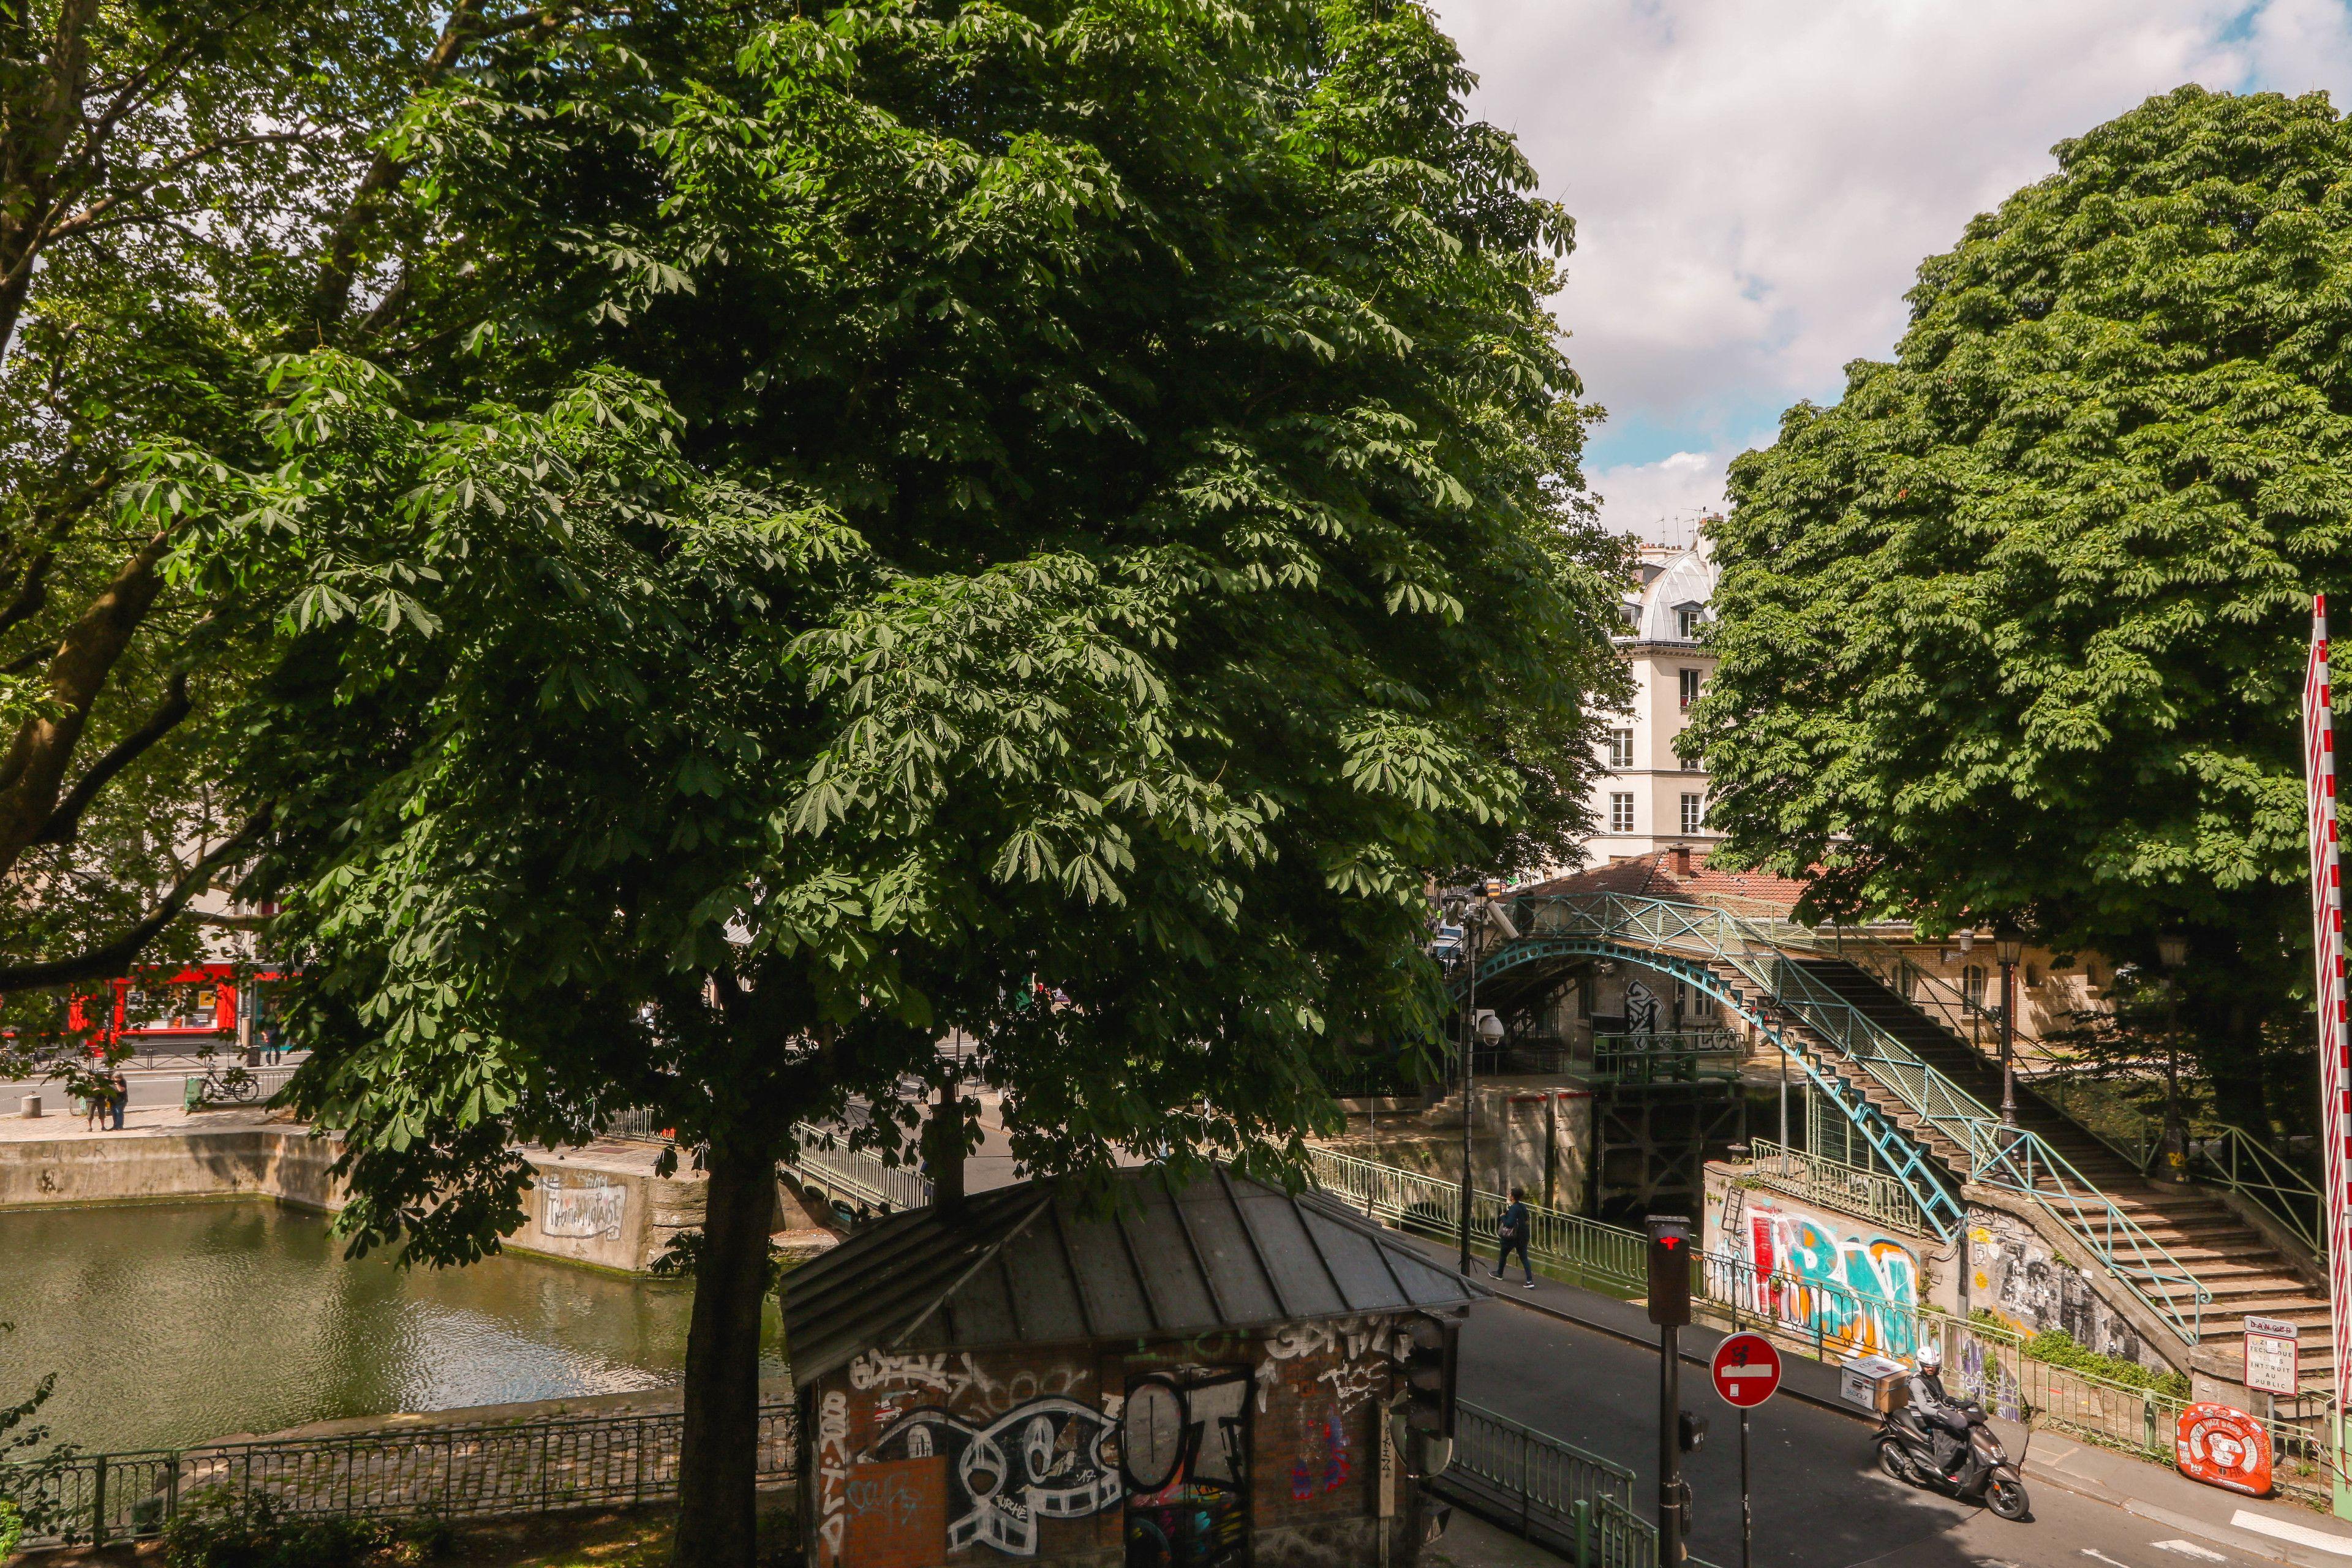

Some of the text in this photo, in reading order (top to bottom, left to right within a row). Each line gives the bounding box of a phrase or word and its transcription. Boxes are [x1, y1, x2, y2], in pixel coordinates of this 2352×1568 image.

[2250, 1321, 2292, 1333] DANGER
[2260, 1340, 2282, 1348] ZE
[2250, 1362, 2290, 1373] INTERDIT
[2255, 1379, 2286, 1389] PUBLIC
